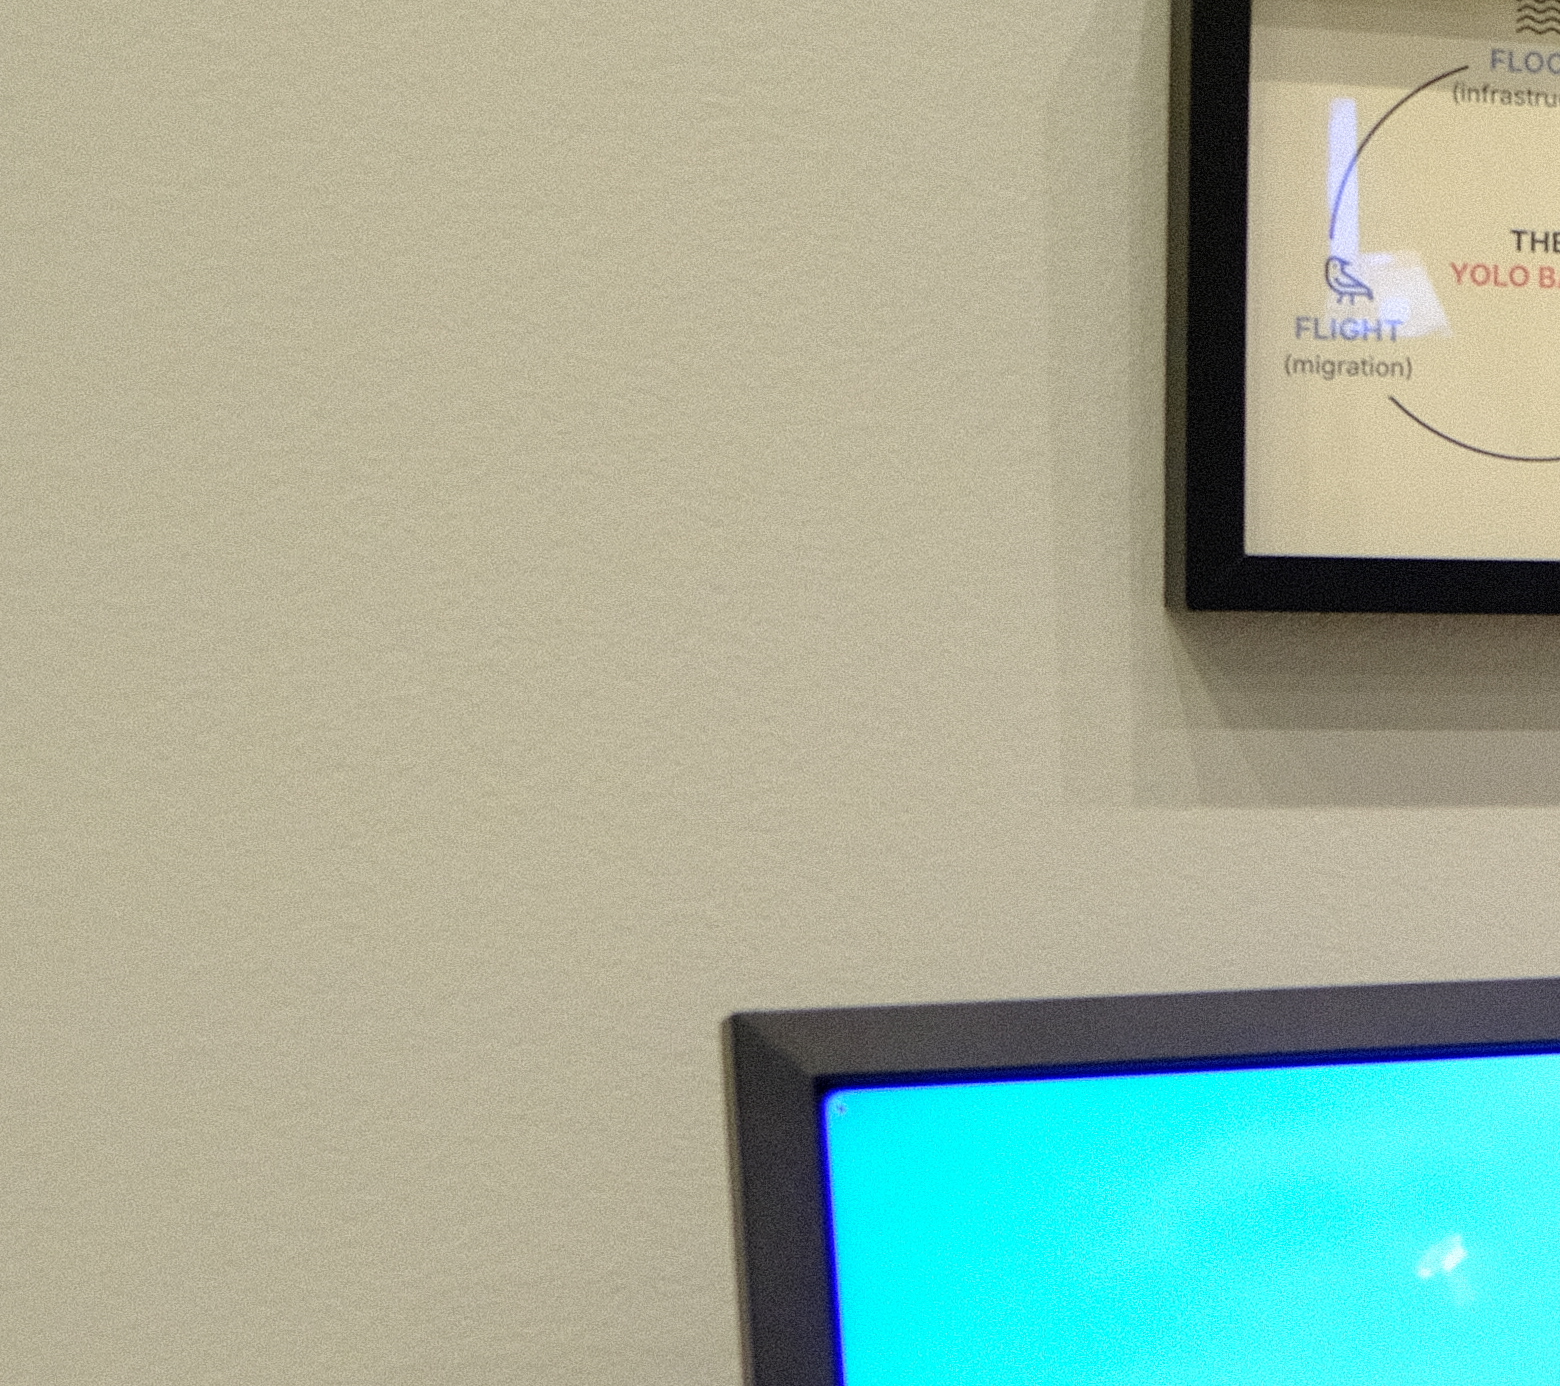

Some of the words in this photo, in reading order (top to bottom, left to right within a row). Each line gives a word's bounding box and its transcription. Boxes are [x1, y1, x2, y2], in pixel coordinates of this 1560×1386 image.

[1449, 261, 1530, 290] YOLO
[1294, 316, 1404, 344] FLIGHT
[1284, 354, 1414, 381] (migration)
